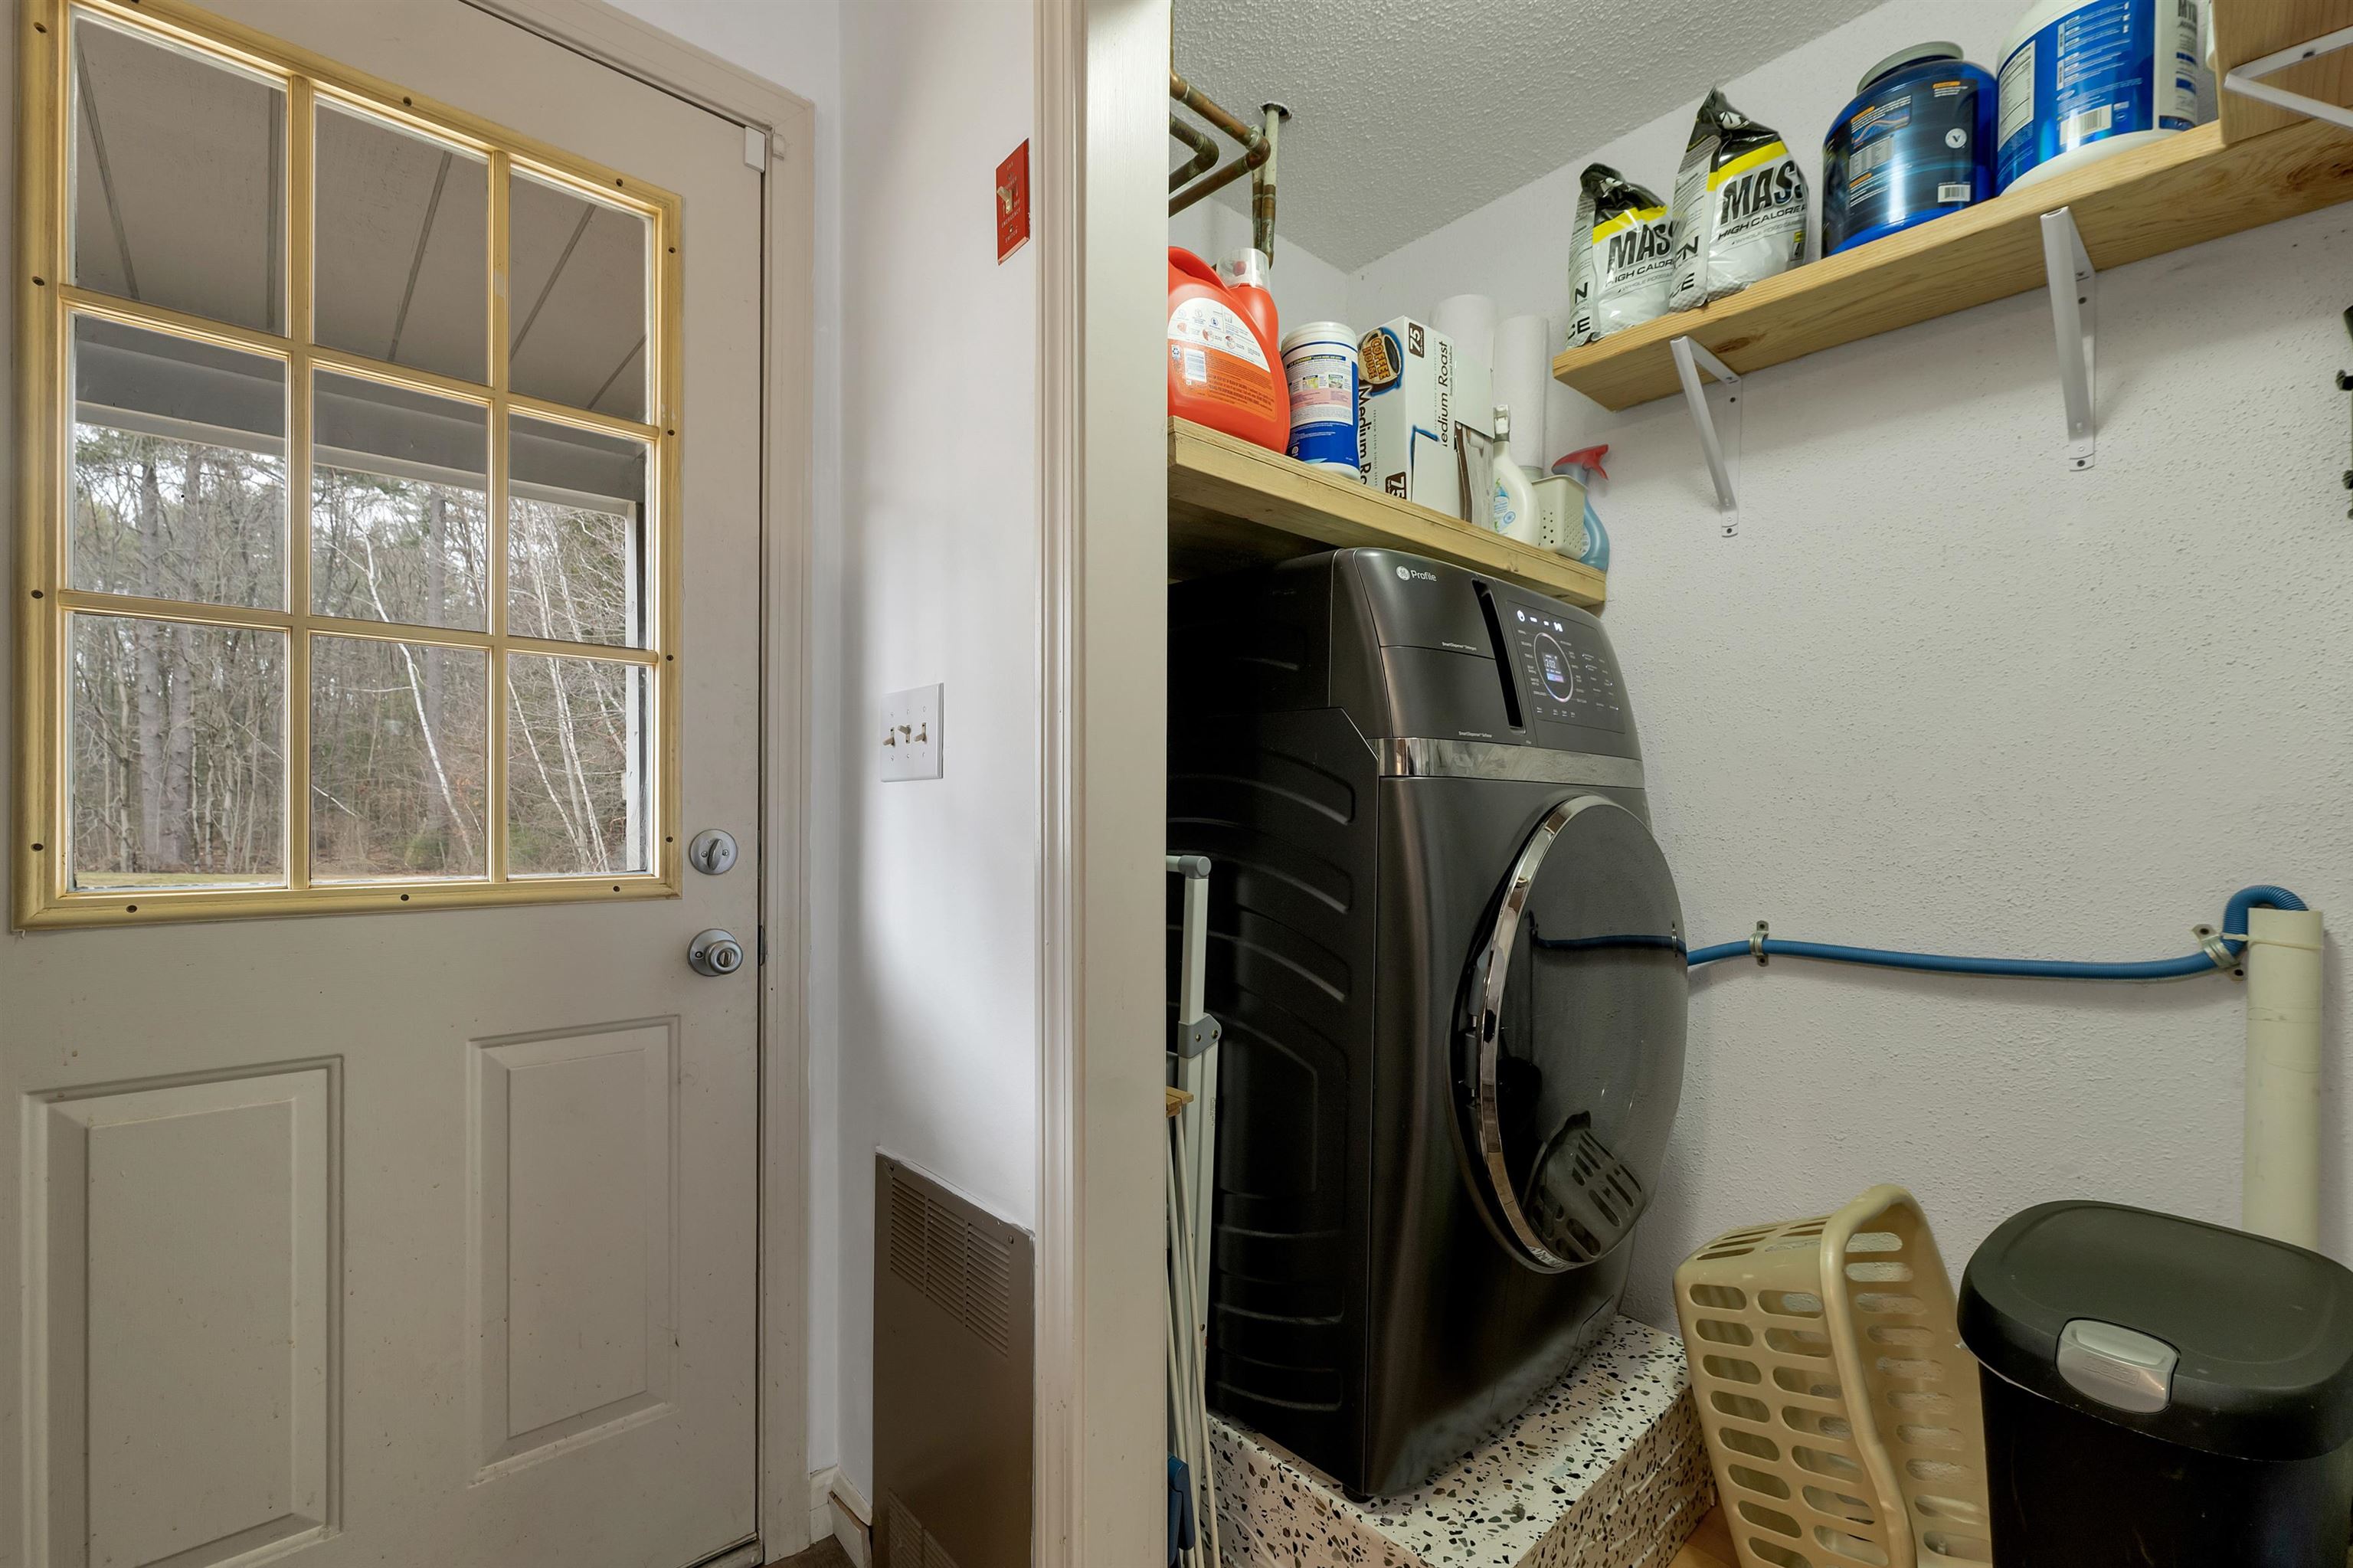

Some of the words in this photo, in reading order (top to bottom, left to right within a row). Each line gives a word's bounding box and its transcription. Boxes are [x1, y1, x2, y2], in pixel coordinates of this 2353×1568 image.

[1001, 208, 1021, 228] EMERGENCY
[1005, 229, 1018, 244] SWITCH
[1717, 223, 1749, 241] HIGH
[1409, 327, 1421, 352] 75
[1362, 347, 1379, 380] HOUSE
[1371, 338, 1391, 380] COFFEE
[1437, 341, 1448, 388] Roast
[1410, 570, 1437, 581] Profile
